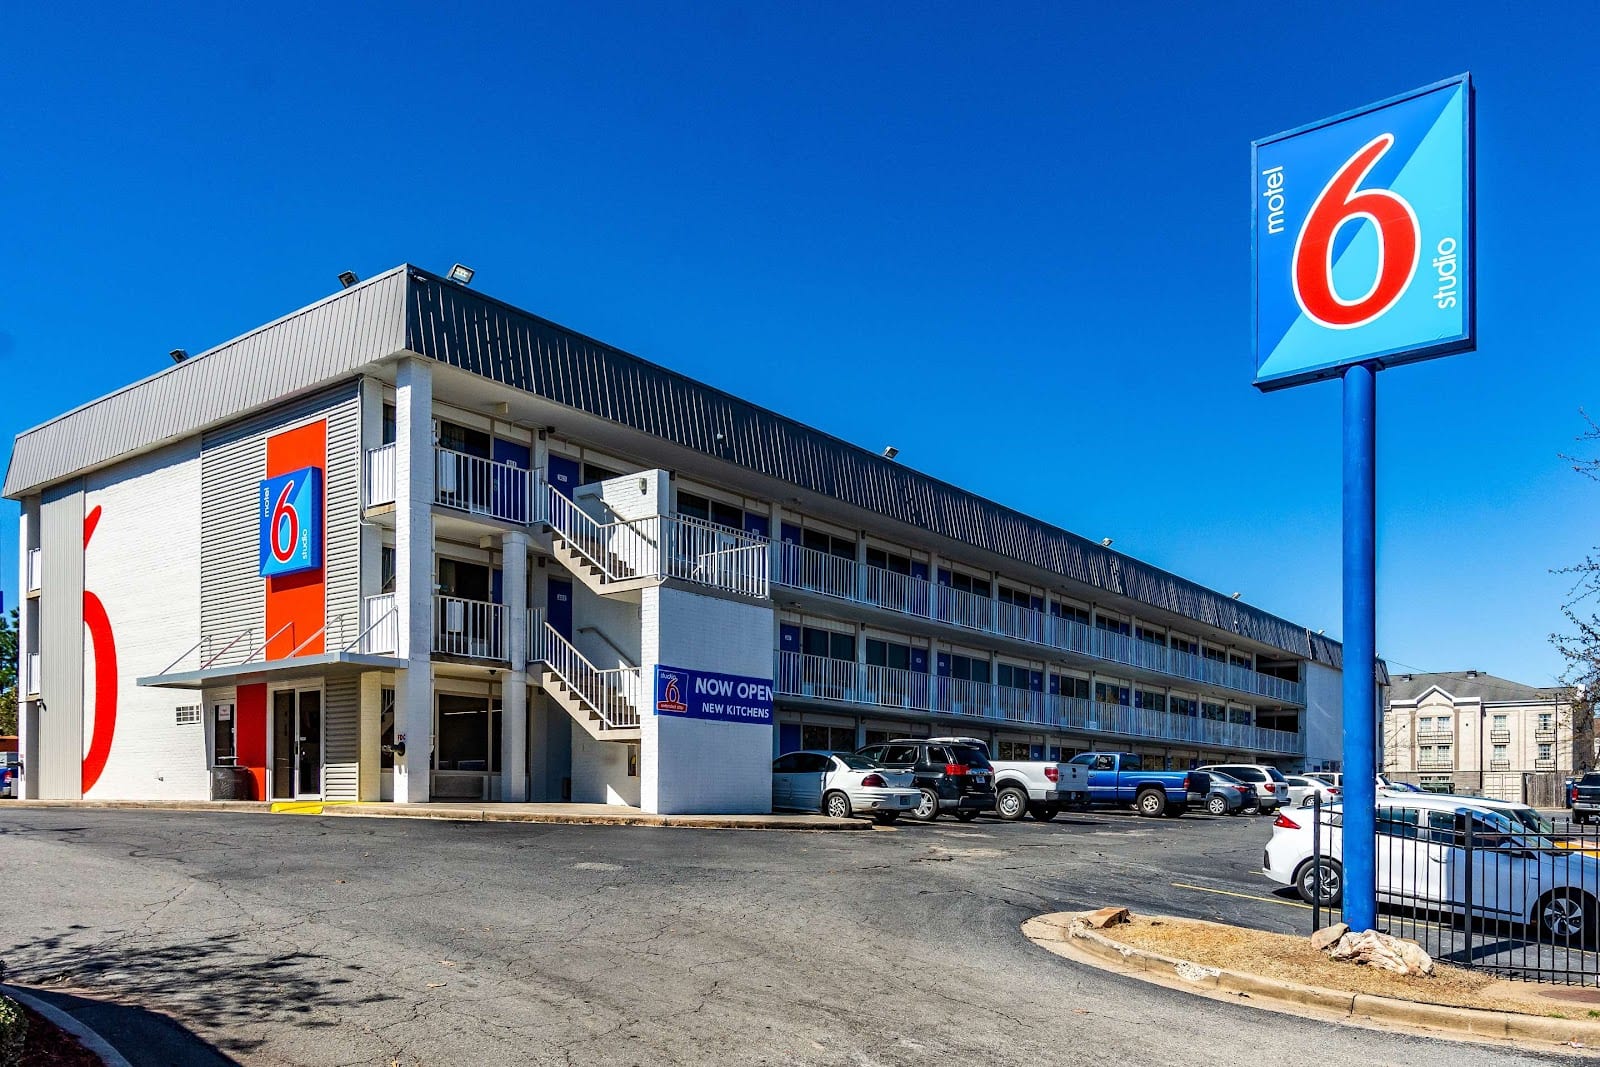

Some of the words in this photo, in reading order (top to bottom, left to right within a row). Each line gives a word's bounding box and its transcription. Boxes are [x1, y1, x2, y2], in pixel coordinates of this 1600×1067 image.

[1263, 165, 1284, 235] motel
[1291, 132, 1422, 330] 6
[1433, 237, 1457, 310] studio
[270, 480, 300, 564] 6
[665, 678, 680, 704] 6
[695, 677, 734, 697] NOW
[737, 682, 774, 702] OPEN
[702, 702, 724, 714] NEW
[726, 705, 770, 719] KITCHENS
